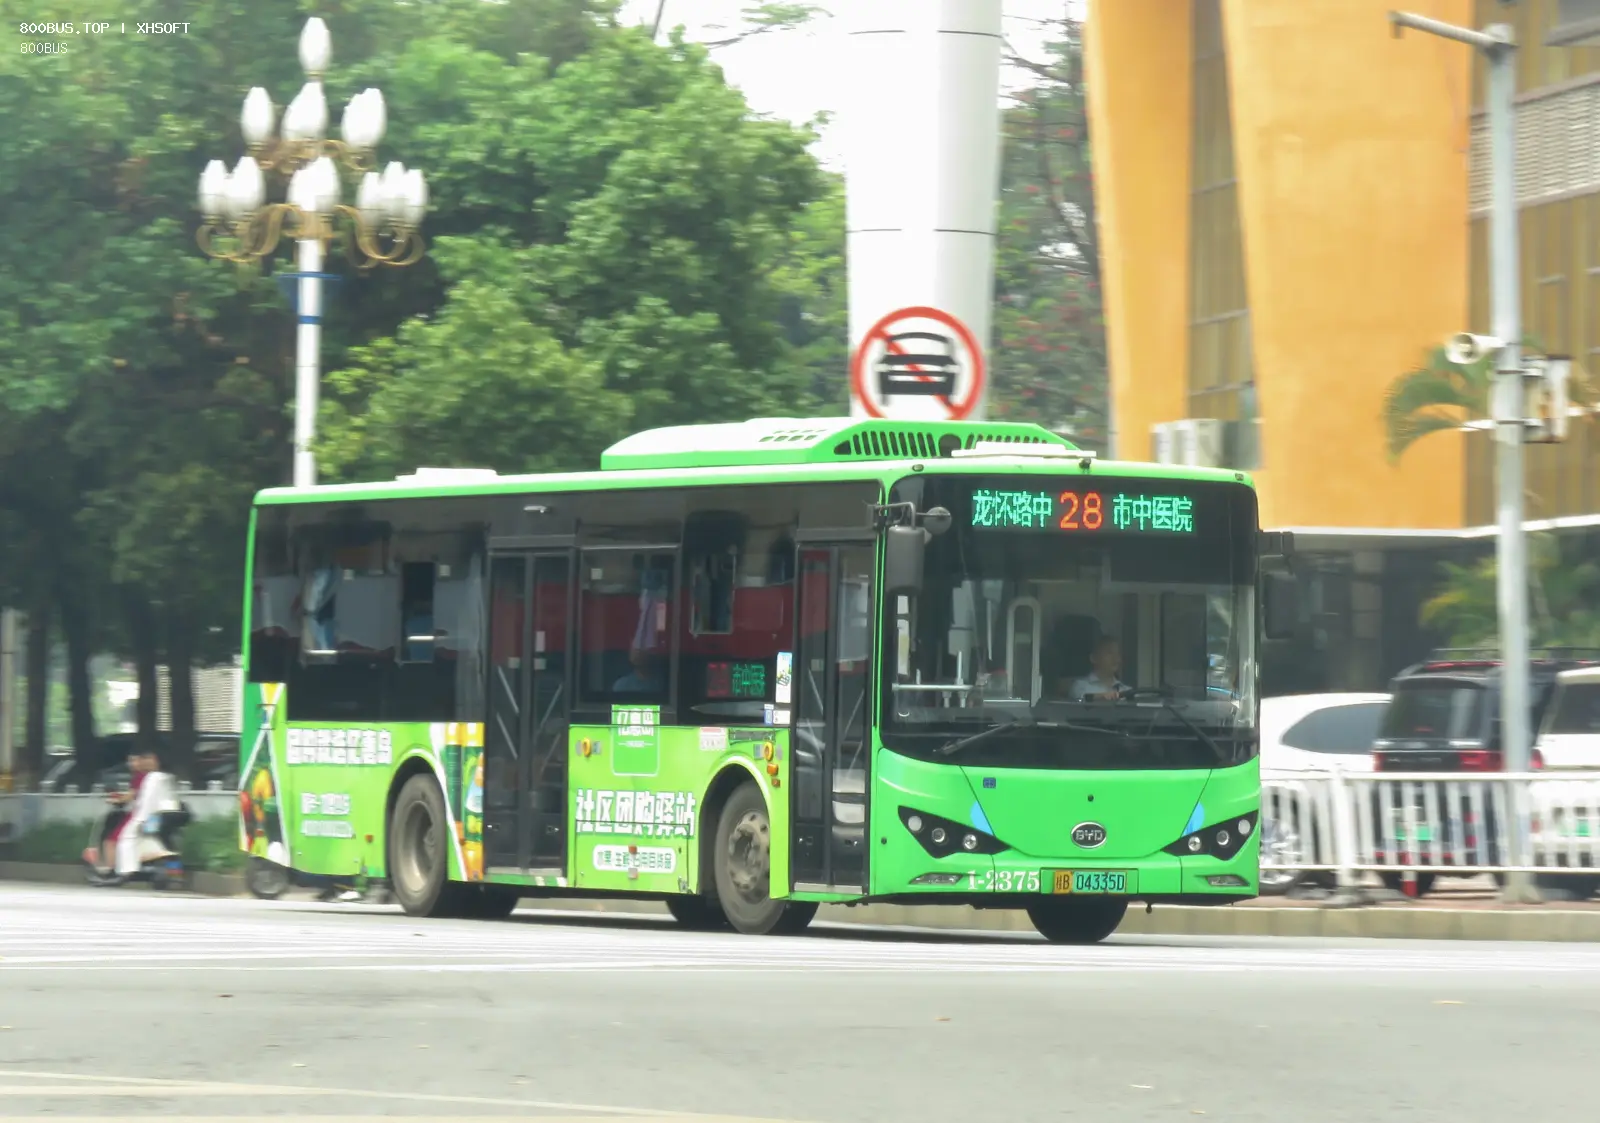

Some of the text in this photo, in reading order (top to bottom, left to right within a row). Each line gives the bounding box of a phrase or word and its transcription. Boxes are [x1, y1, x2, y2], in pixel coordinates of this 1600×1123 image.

[972, 489, 1193, 532] 龙怀路中 28 市中医院
[576, 788, 696, 836] 社区团购驿站
[1075, 829, 1104, 841] BYD
[967, 869, 1040, 891] 1-2375
[1076, 873, 1125, 891] 04335D
